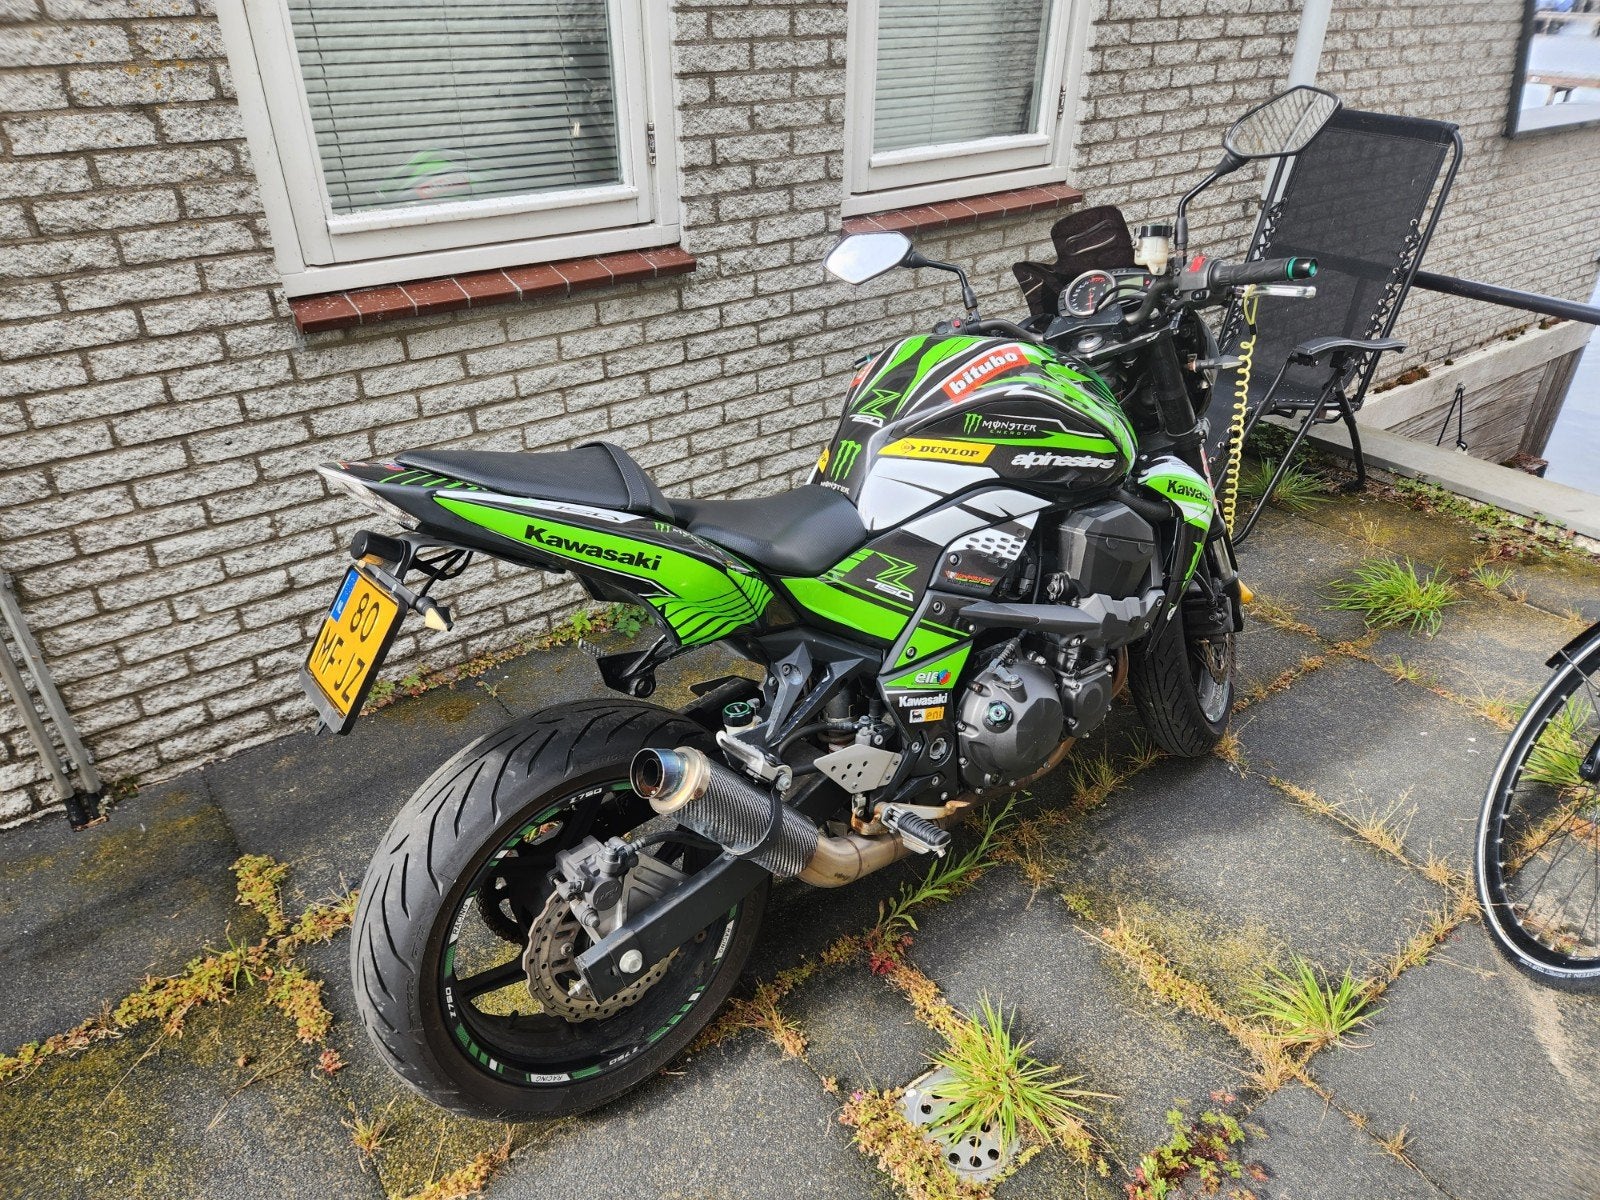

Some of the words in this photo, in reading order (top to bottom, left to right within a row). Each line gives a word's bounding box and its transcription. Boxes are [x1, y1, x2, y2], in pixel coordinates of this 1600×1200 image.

[948, 351, 1018, 395] bitubo
[918, 445, 980, 457] DUNLOP
[1010, 451, 1117, 470] alpinestars
[524, 524, 663, 571] Kawasaki
[350, 592, 380, 642] 80
[914, 671, 939, 684] elf
[898, 692, 948, 708] Kawasaki
[925, 707, 942, 720] eni
[452, 904, 469, 935] RACING
[718, 927, 732, 954] RACING
[445, 986, 457, 1019] Z750
[534, 1074, 564, 1082] RACING
